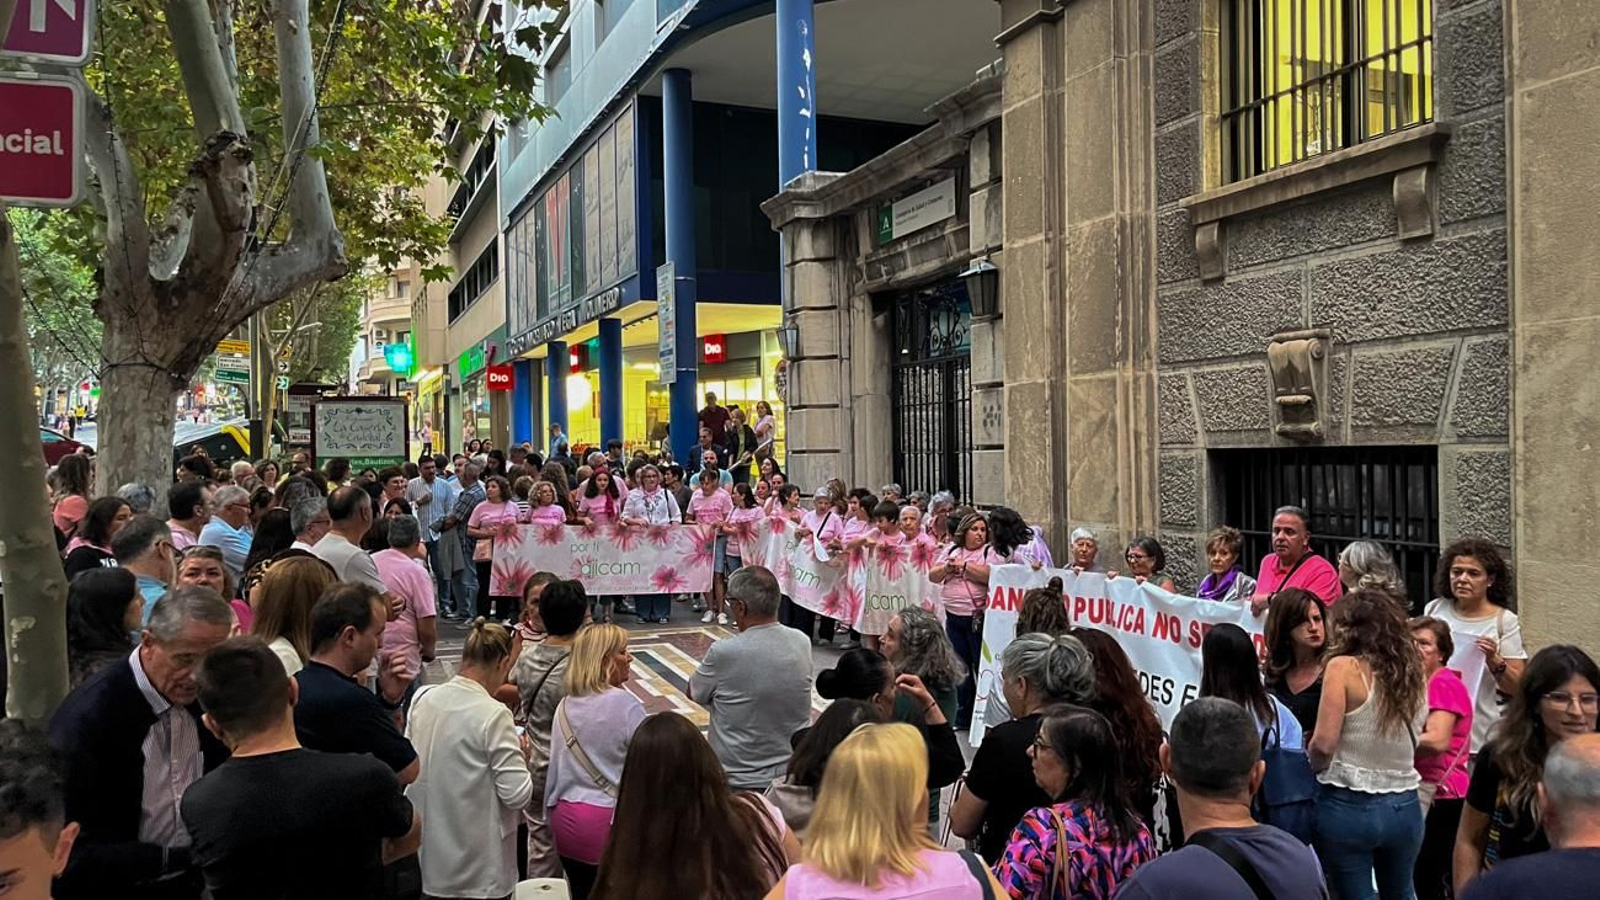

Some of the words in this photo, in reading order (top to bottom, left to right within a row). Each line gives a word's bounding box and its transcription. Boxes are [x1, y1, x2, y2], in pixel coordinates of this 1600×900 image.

[570, 541, 588, 553] por
[580, 559, 641, 578] ajicam
[1152, 611, 1181, 643] NO
[1134, 669, 1174, 705] DES
